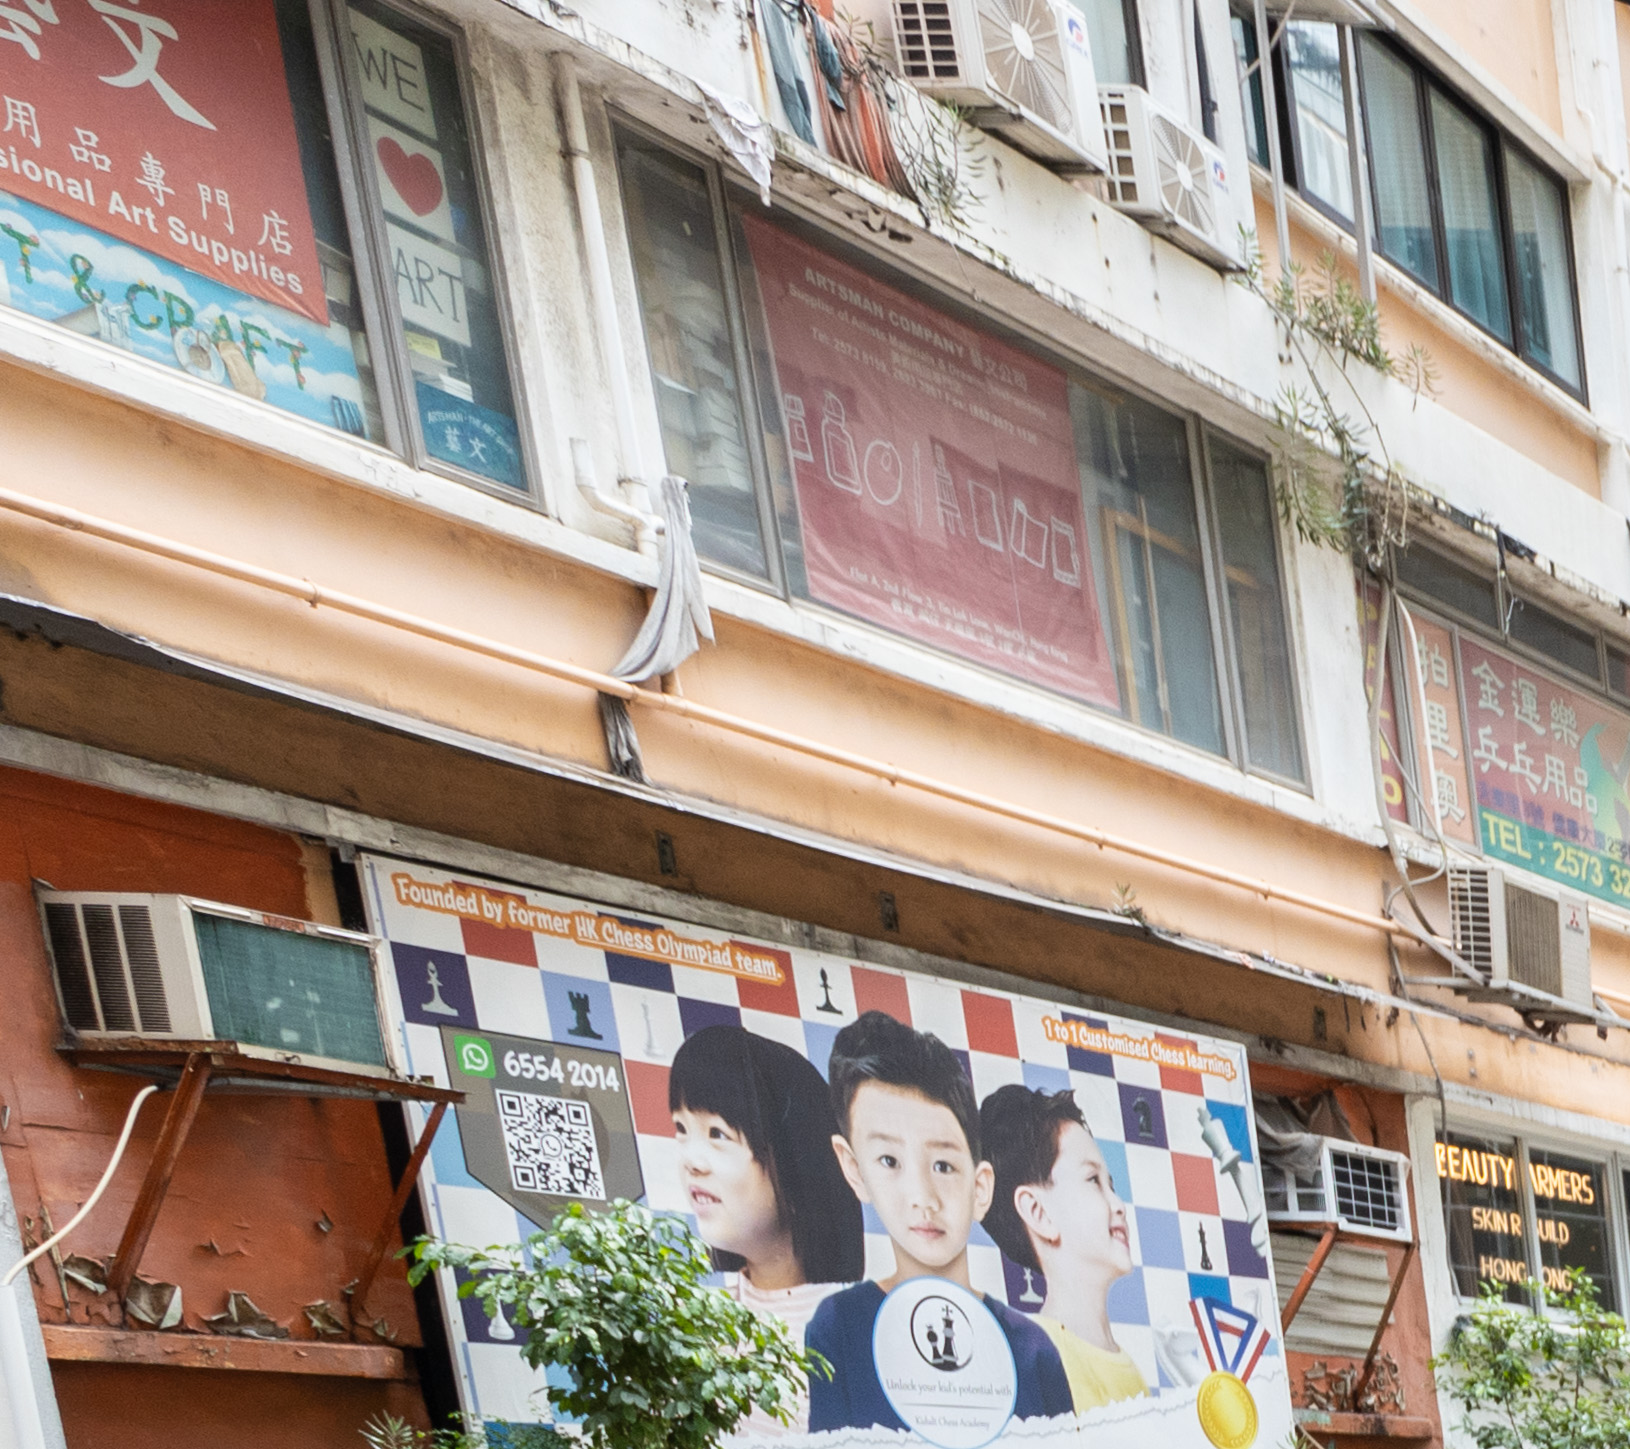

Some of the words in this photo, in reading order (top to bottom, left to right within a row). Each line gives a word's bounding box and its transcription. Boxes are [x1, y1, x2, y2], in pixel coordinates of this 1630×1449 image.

[351, 31, 424, 112] WE
[3, 95, 293, 256] 用品專門店
[70, 254, 106, 305] &
[108, 191, 158, 234] Art
[168, 216, 304, 295] Supplies
[394, 247, 463, 324] ART
[805, 268, 885, 320] ARTSMAN
[889, 312, 964, 358] COMPANY
[1473, 724, 1599, 817] 乒乓用品
[1482, 811, 1532, 861] TEL
[1553, 841, 1605, 889] 2573
[396, 877, 479, 917] Founded
[482, 893, 503, 924] by
[508, 903, 571, 935] former
[575, 915, 600, 941] HK
[602, 922, 655, 953] Chess
[657, 933, 732, 969] Olympiad
[735, 950, 783, 980] team.
[503, 1050, 565, 1084] 6554
[567, 1061, 621, 1094] 2014
[1044, 1018, 1053, 1038] 1
[1055, 1023, 1069, 1041] to
[1070, 1024, 1078, 1043] 1
[1079, 1026, 1150, 1059] Customised
[1150, 1042, 1186, 1067] Chess
[1186, 1049, 1236, 1079] learning.
[1434, 1142, 1515, 1190] BEAUTY
[1526, 1161, 1595, 1206] ARMERS
[1472, 1206, 1508, 1233] SKIN
[1510, 1212, 1570, 1245] RUILD
[1480, 1255, 1528, 1285] HONG
[1540, 1267, 1574, 1293] ONG
[886, 1378, 919, 1392] Unlock
[918, 1382, 937, 1396] your
[959, 1382, 993, 1397] potential
[994, 1384, 1013, 1397] with
